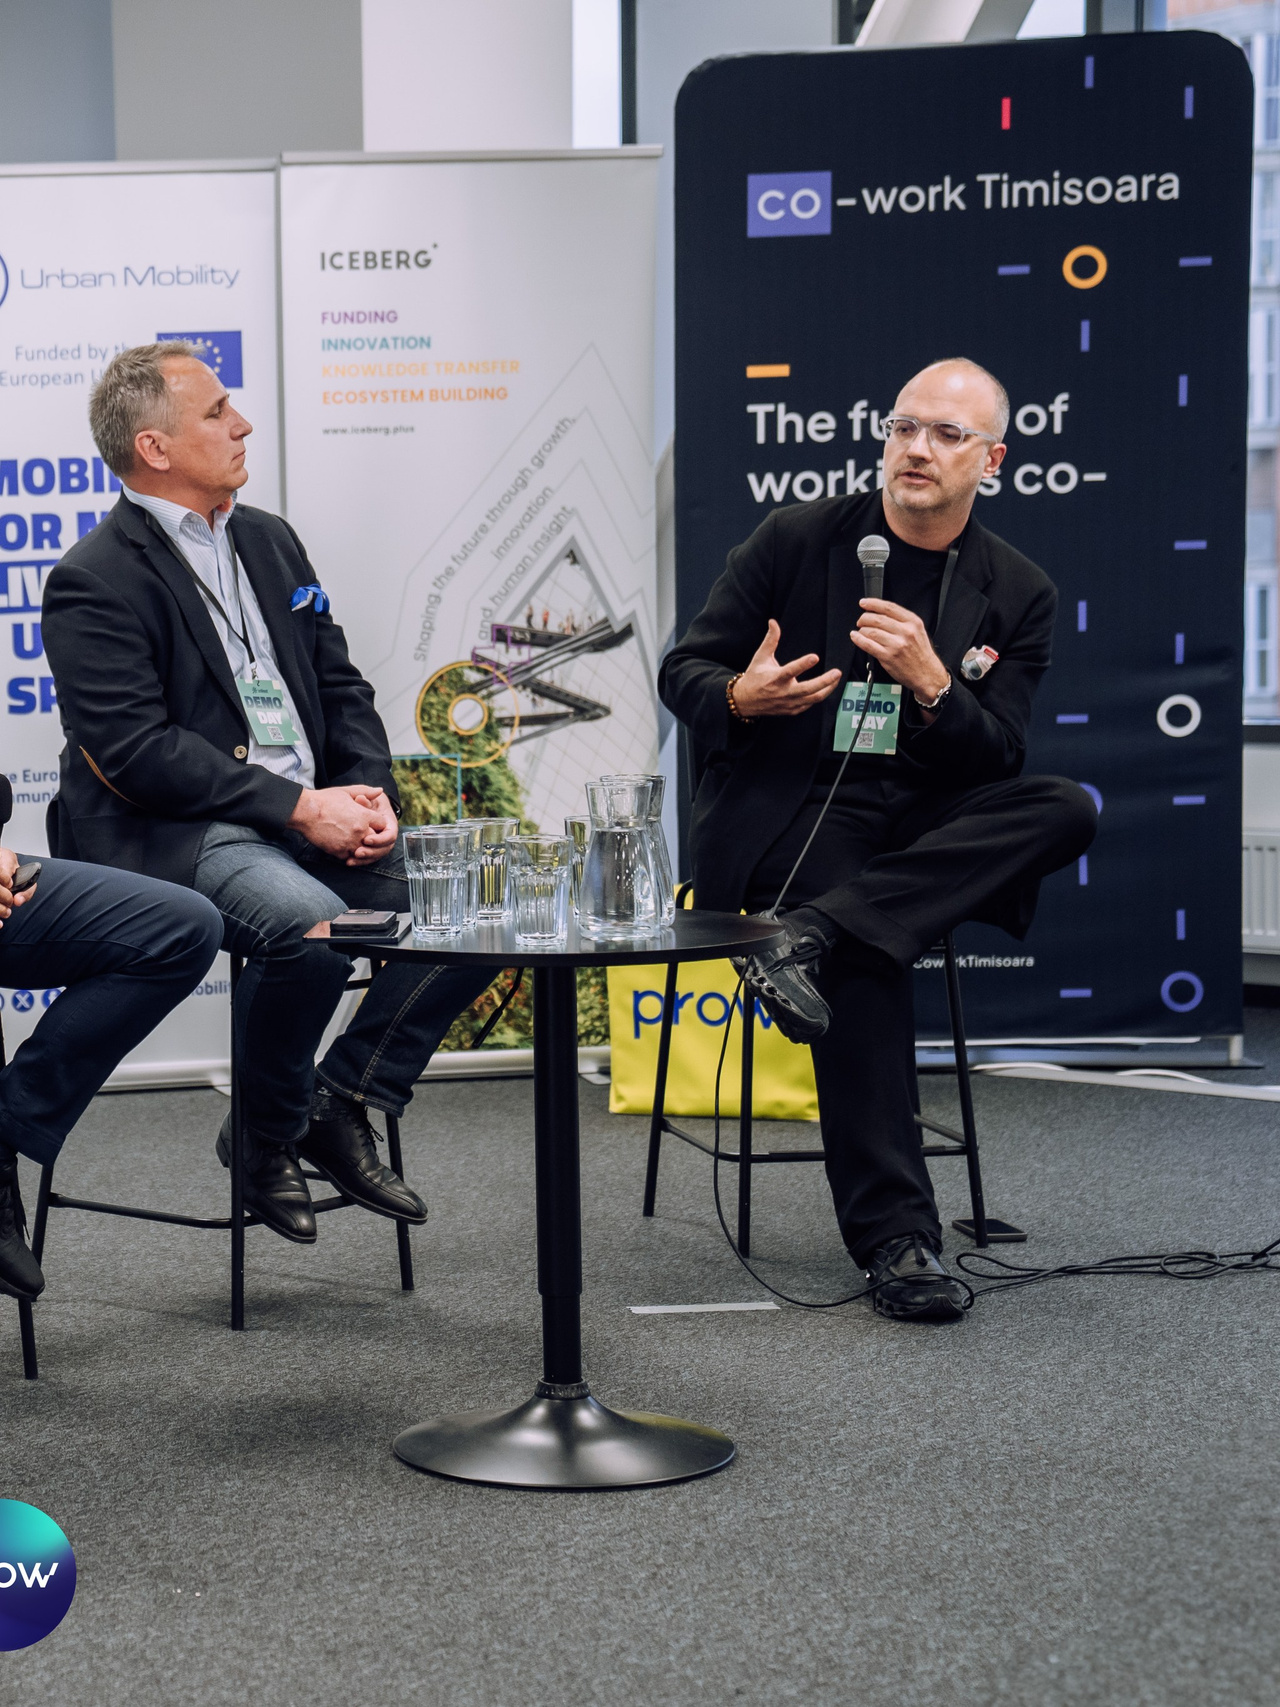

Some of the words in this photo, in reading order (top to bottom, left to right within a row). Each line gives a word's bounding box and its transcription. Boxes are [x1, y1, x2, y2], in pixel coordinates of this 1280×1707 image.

[977, 170, 1180, 209] Timisoara
[20, 268, 116, 289] Urban
[123, 264, 240, 288] Mobility
[321, 310, 398, 325] FUNDING
[15, 344, 81, 361] Funded
[87, 343, 109, 362] by
[321, 336, 431, 352] INNOVATION
[322, 362, 429, 378] KNOWLEDGE
[434, 359, 520, 375] TRANSFER
[0, 370, 84, 388] European
[323, 388, 424, 404] ECOSYSTEM
[429, 386, 508, 402] BUILDING
[747, 403, 836, 444] The
[1014, 392, 1070, 436] of
[322, 425, 415, 436] www.iceberg.plus
[1014, 461, 1107, 495] co-
[492, 485, 554, 560] innovation
[414, 594, 442, 662] Shaping
[432, 566, 456, 590] the
[451, 523, 489, 566] future
[485, 467, 534, 524] through
[477, 607, 493, 640] and
[491, 554, 533, 607] human
[244, 696, 283, 709] DEMO
[841, 698, 896, 715] DEMO
[256, 711, 283, 725] DAY
[851, 715, 888, 730] DAY
